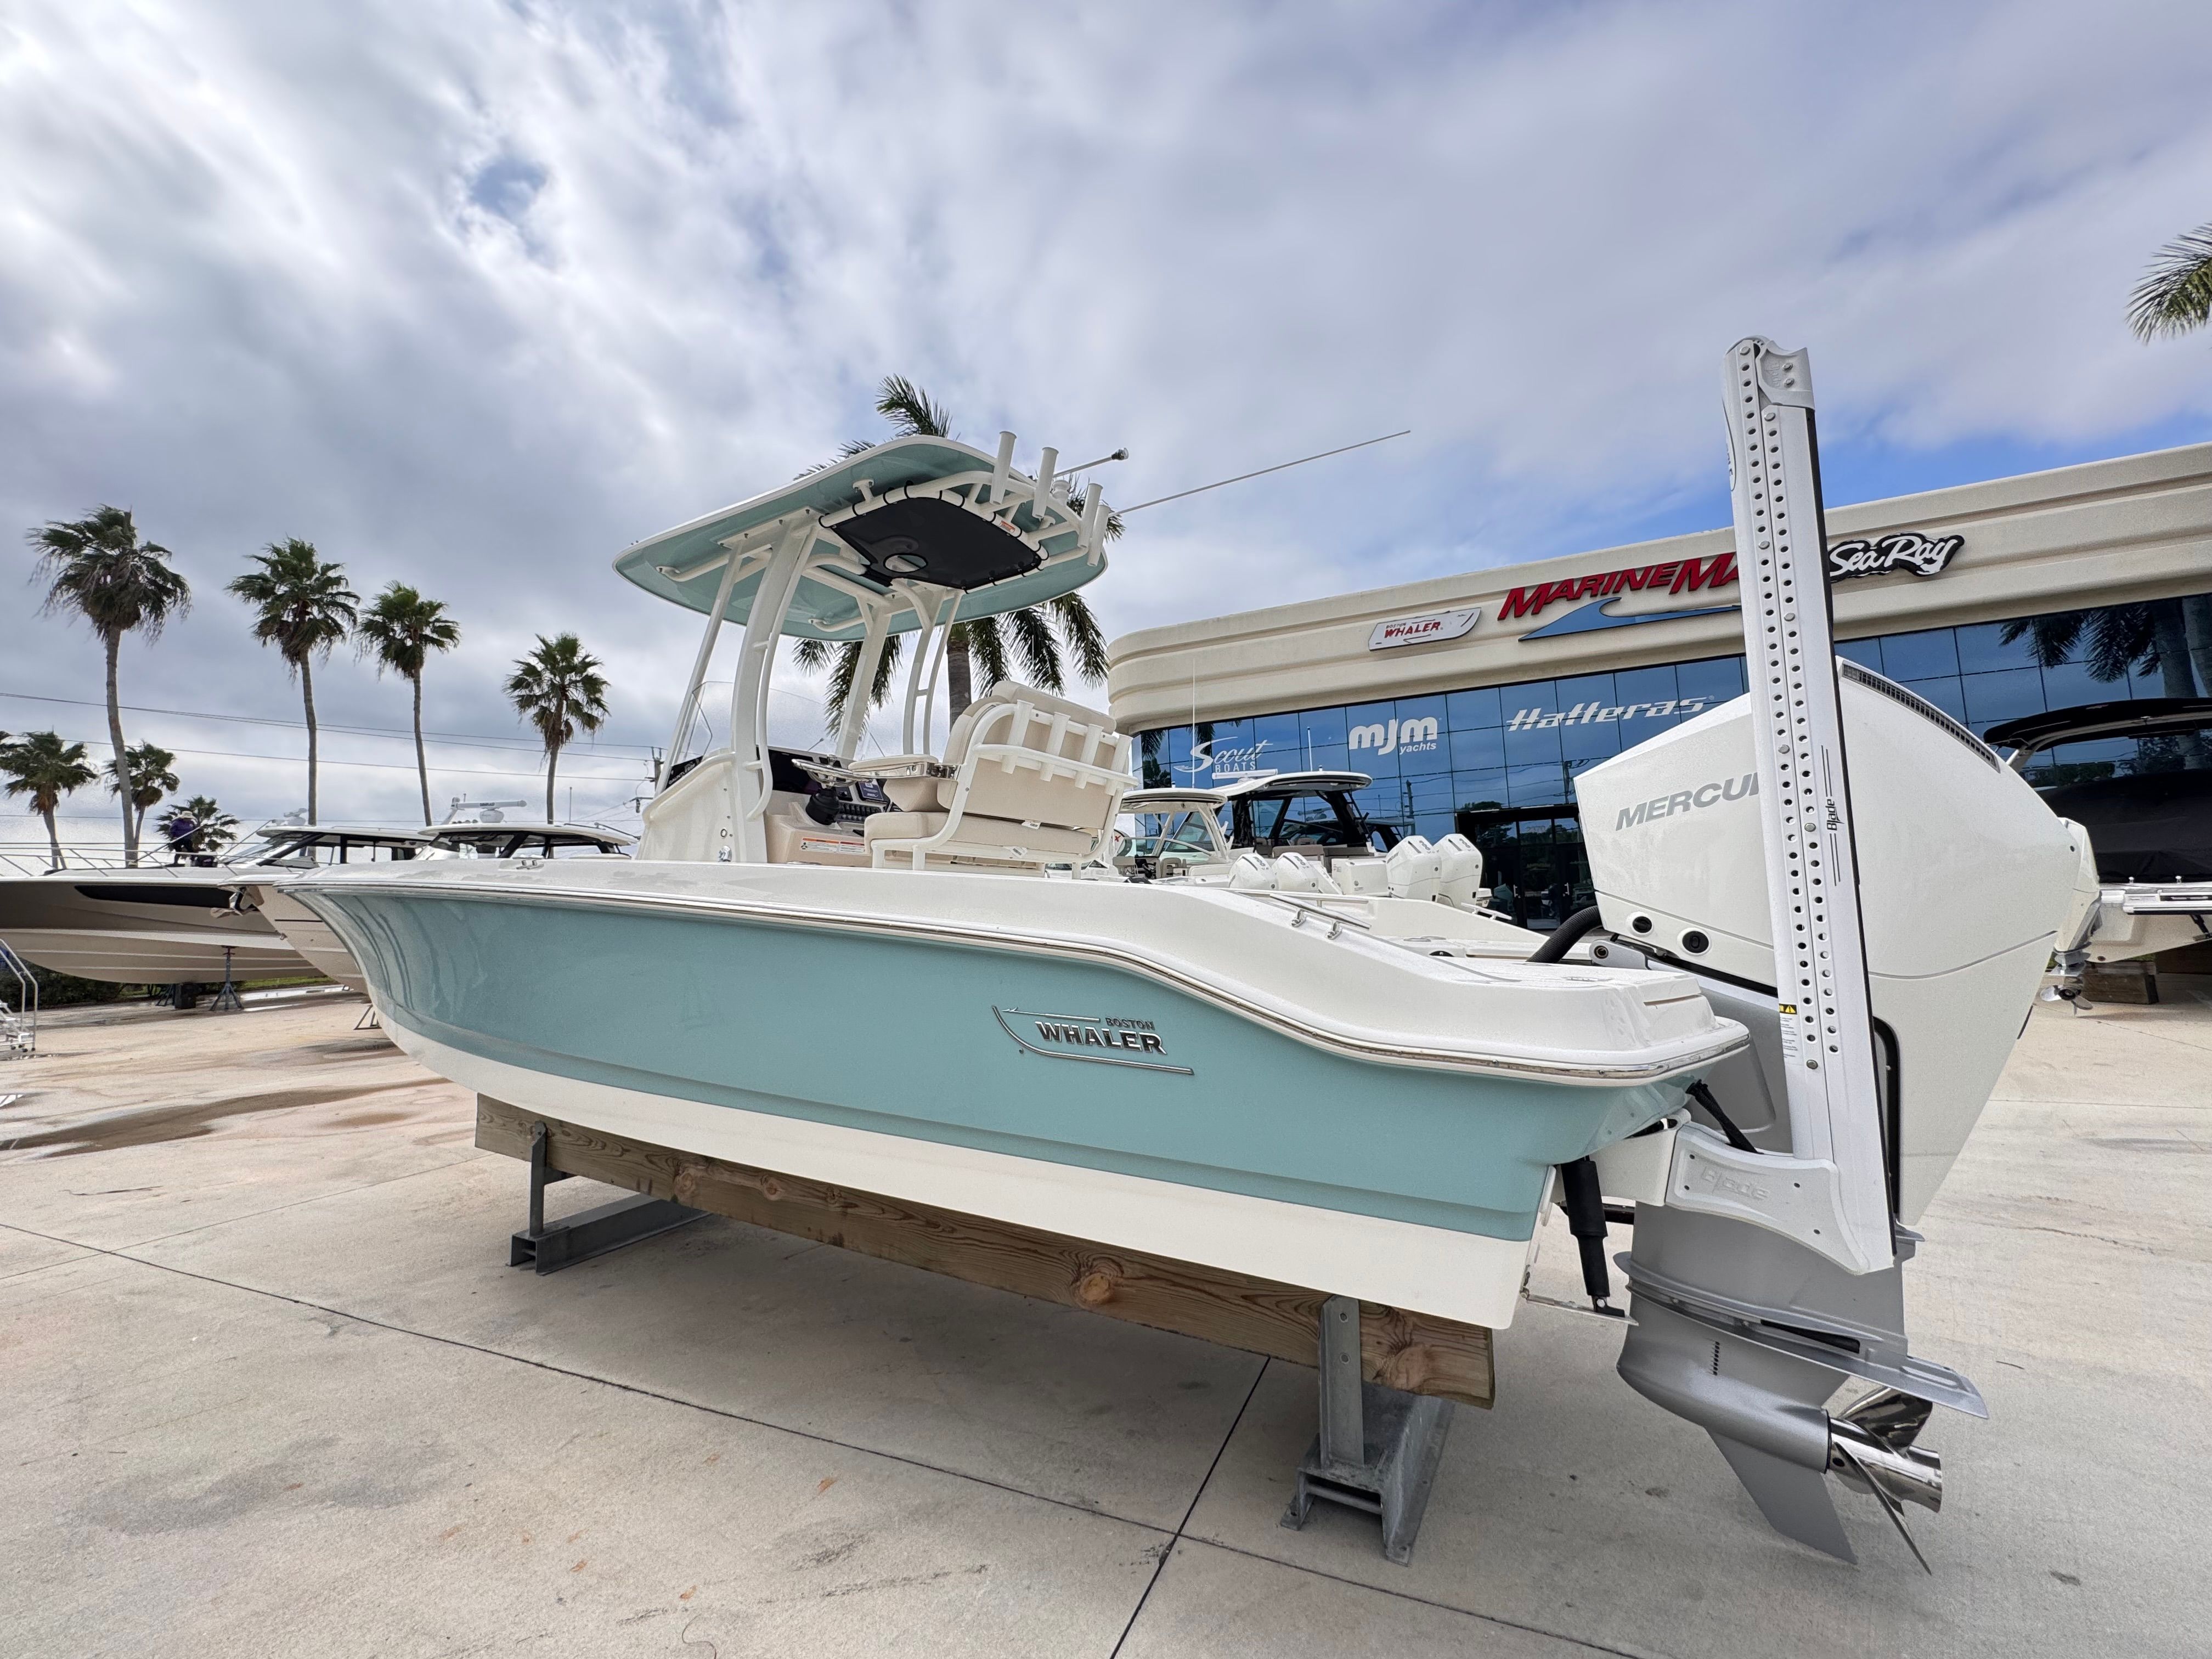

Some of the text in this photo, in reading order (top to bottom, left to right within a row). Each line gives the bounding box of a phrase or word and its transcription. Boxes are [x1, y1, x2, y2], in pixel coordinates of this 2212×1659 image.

[1829, 535, 1958, 577] Sea Ray
[1497, 552, 1739, 620] MARINEM
[1384, 621, 1441, 638] WHALER
[1506, 697, 1707, 731] Hatteras
[1173, 737, 1273, 773] Scout
[1400, 742, 1437, 755] yachts
[1215, 761, 1256, 773] BOATS
[1616, 772, 1759, 831] MERCU
[1825, 799, 1844, 831] Blade
[1035, 1021, 1167, 1055] WHALER
[1105, 1017, 1155, 1031] BOSTON
